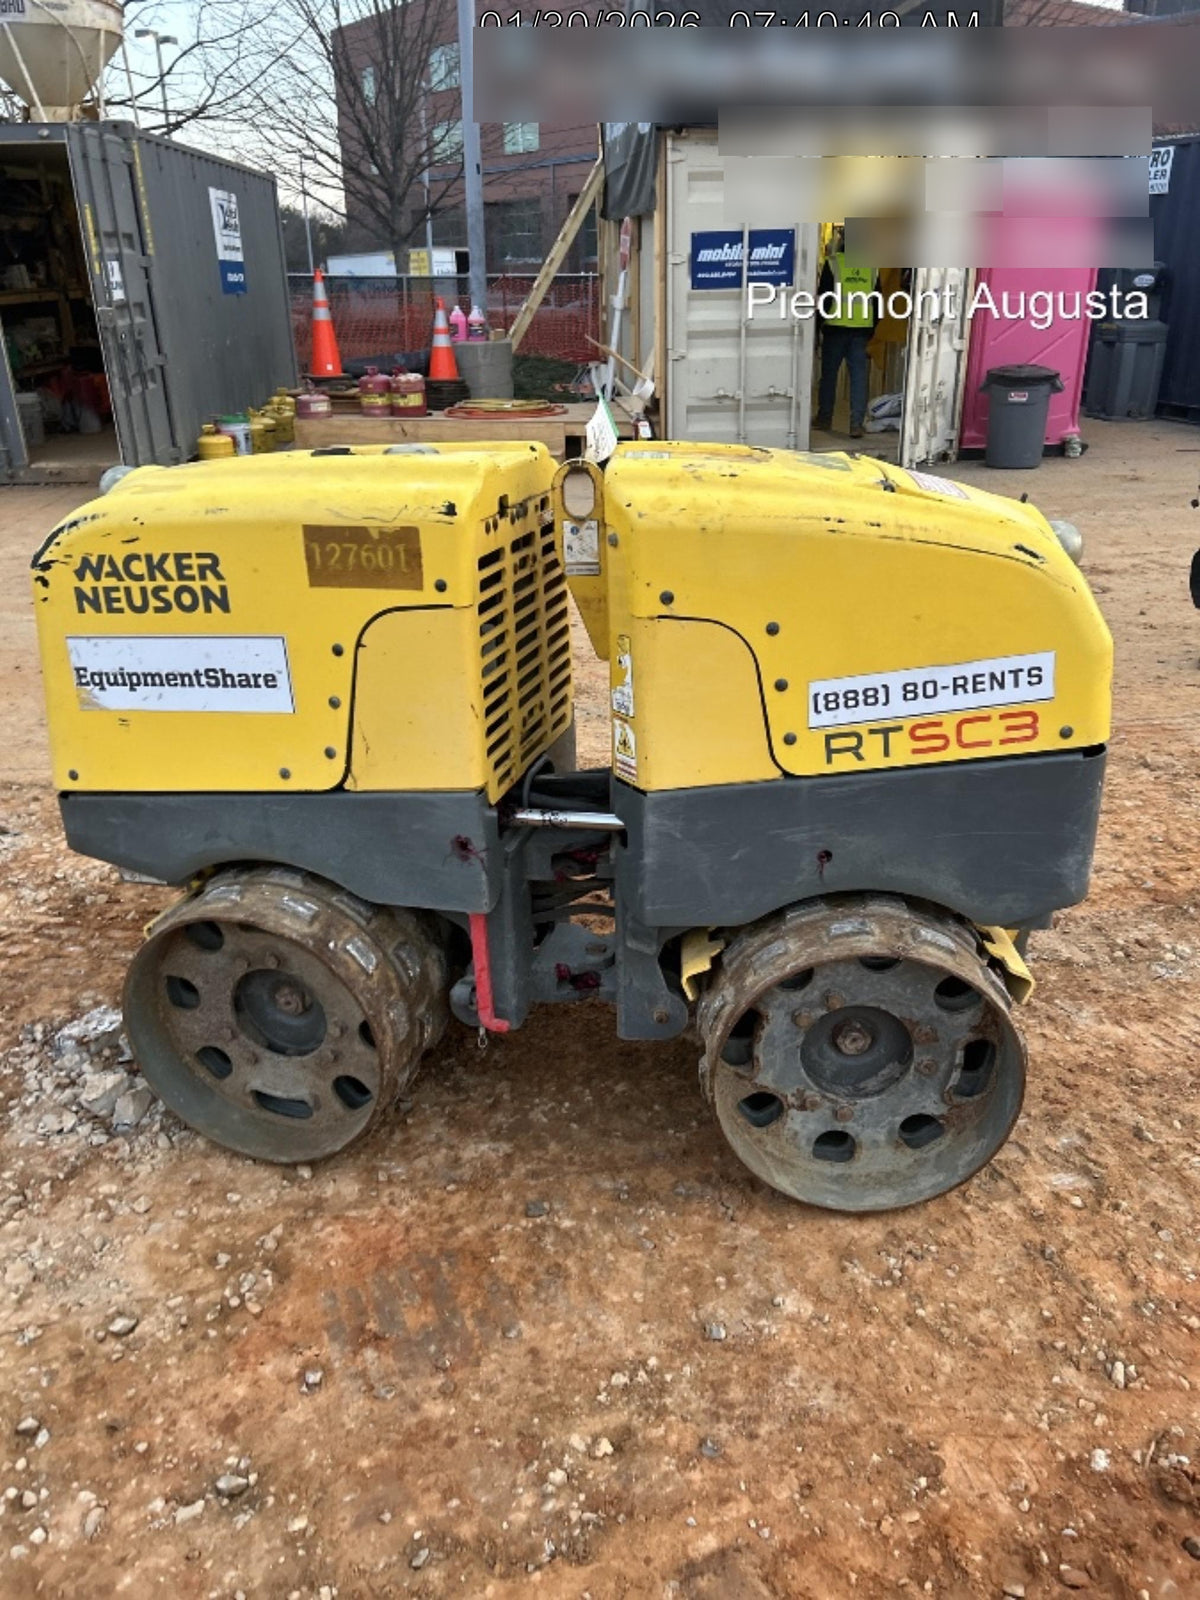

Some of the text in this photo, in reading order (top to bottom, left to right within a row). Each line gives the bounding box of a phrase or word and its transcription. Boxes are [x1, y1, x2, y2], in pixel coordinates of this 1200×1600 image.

[750, 243, 788, 260] mini
[73, 552, 226, 582] WACKER
[310, 542, 410, 573] 127601
[74, 584, 231, 614] NEUSON
[74, 666, 279, 692] EquipmentShare
[813, 666, 1043, 714] (888) 80-RENTS
[824, 711, 1039, 765] RTSC3
